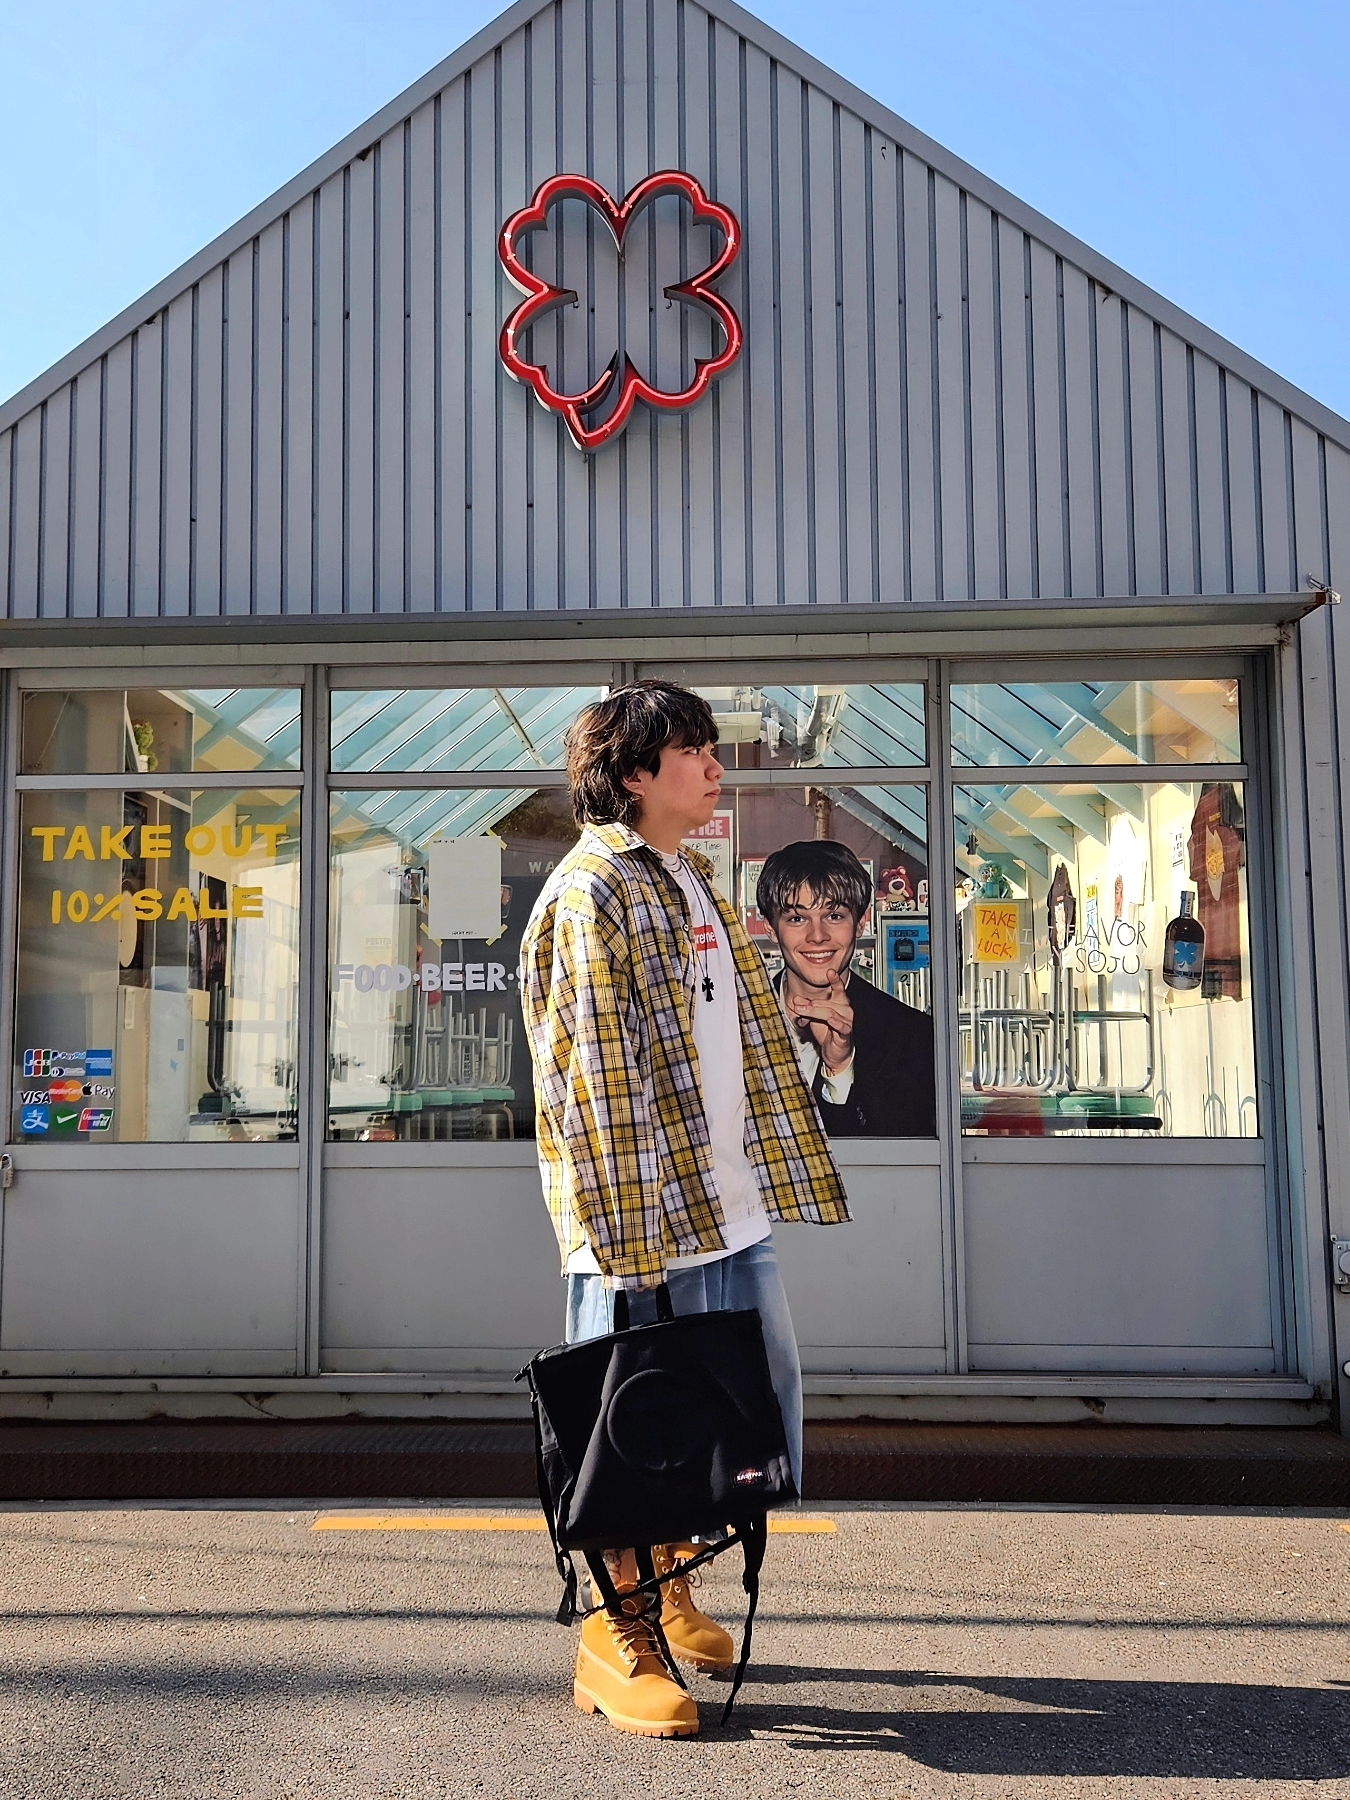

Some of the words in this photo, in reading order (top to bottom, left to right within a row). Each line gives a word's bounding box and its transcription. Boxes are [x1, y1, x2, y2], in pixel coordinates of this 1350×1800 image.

[689, 820, 723, 836] ICE
[31, 824, 172, 862] TAKE
[184, 824, 287, 857] OUT
[51, 889, 123, 924] 10%
[133, 887, 263, 922] SALE
[979, 909, 1017, 930] TAKE
[991, 928, 1000, 940] A
[1075, 947, 1140, 974] SOJU
[25, 1059, 51, 1067] JCB
[20, 1091, 51, 1104] VISA
[94, 1084, 115, 1099] Pay
